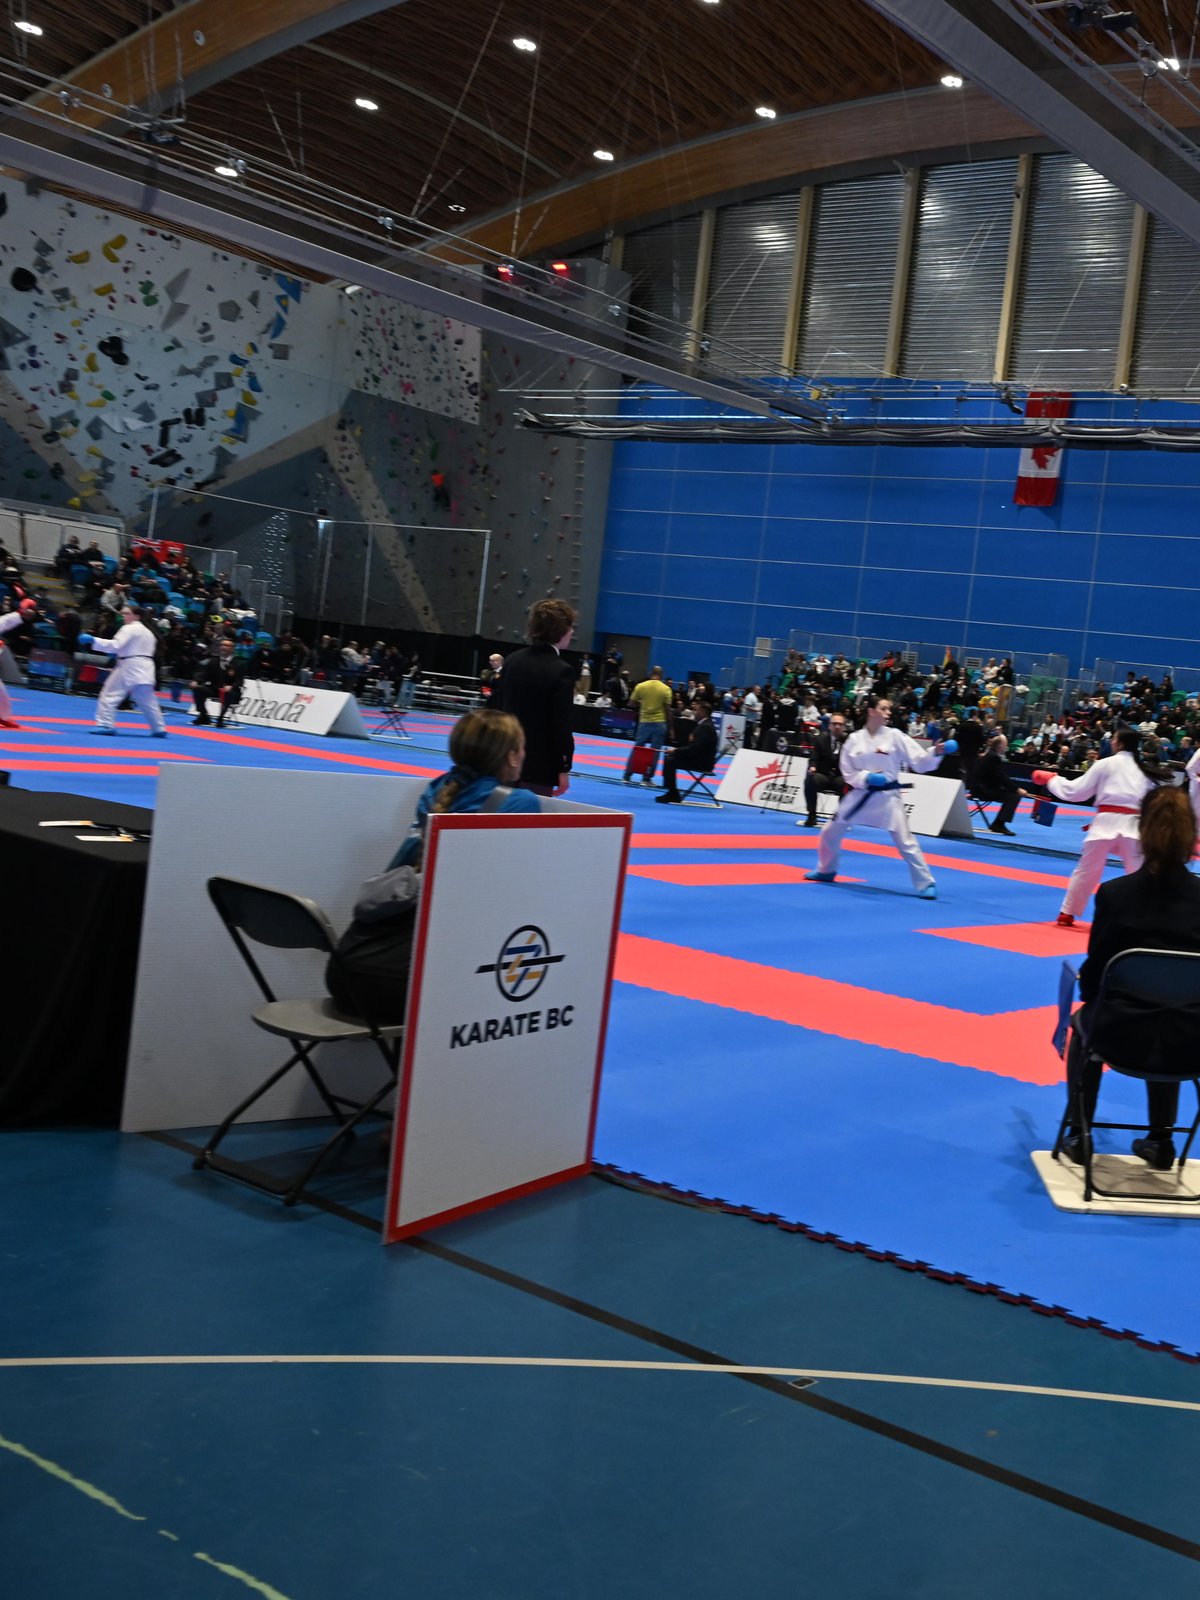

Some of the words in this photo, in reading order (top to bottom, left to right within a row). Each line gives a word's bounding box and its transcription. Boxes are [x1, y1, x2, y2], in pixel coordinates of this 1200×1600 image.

[232, 694, 306, 723] anada
[450, 1010, 542, 1049] KARATE
[545, 1004, 575, 1030] BC
